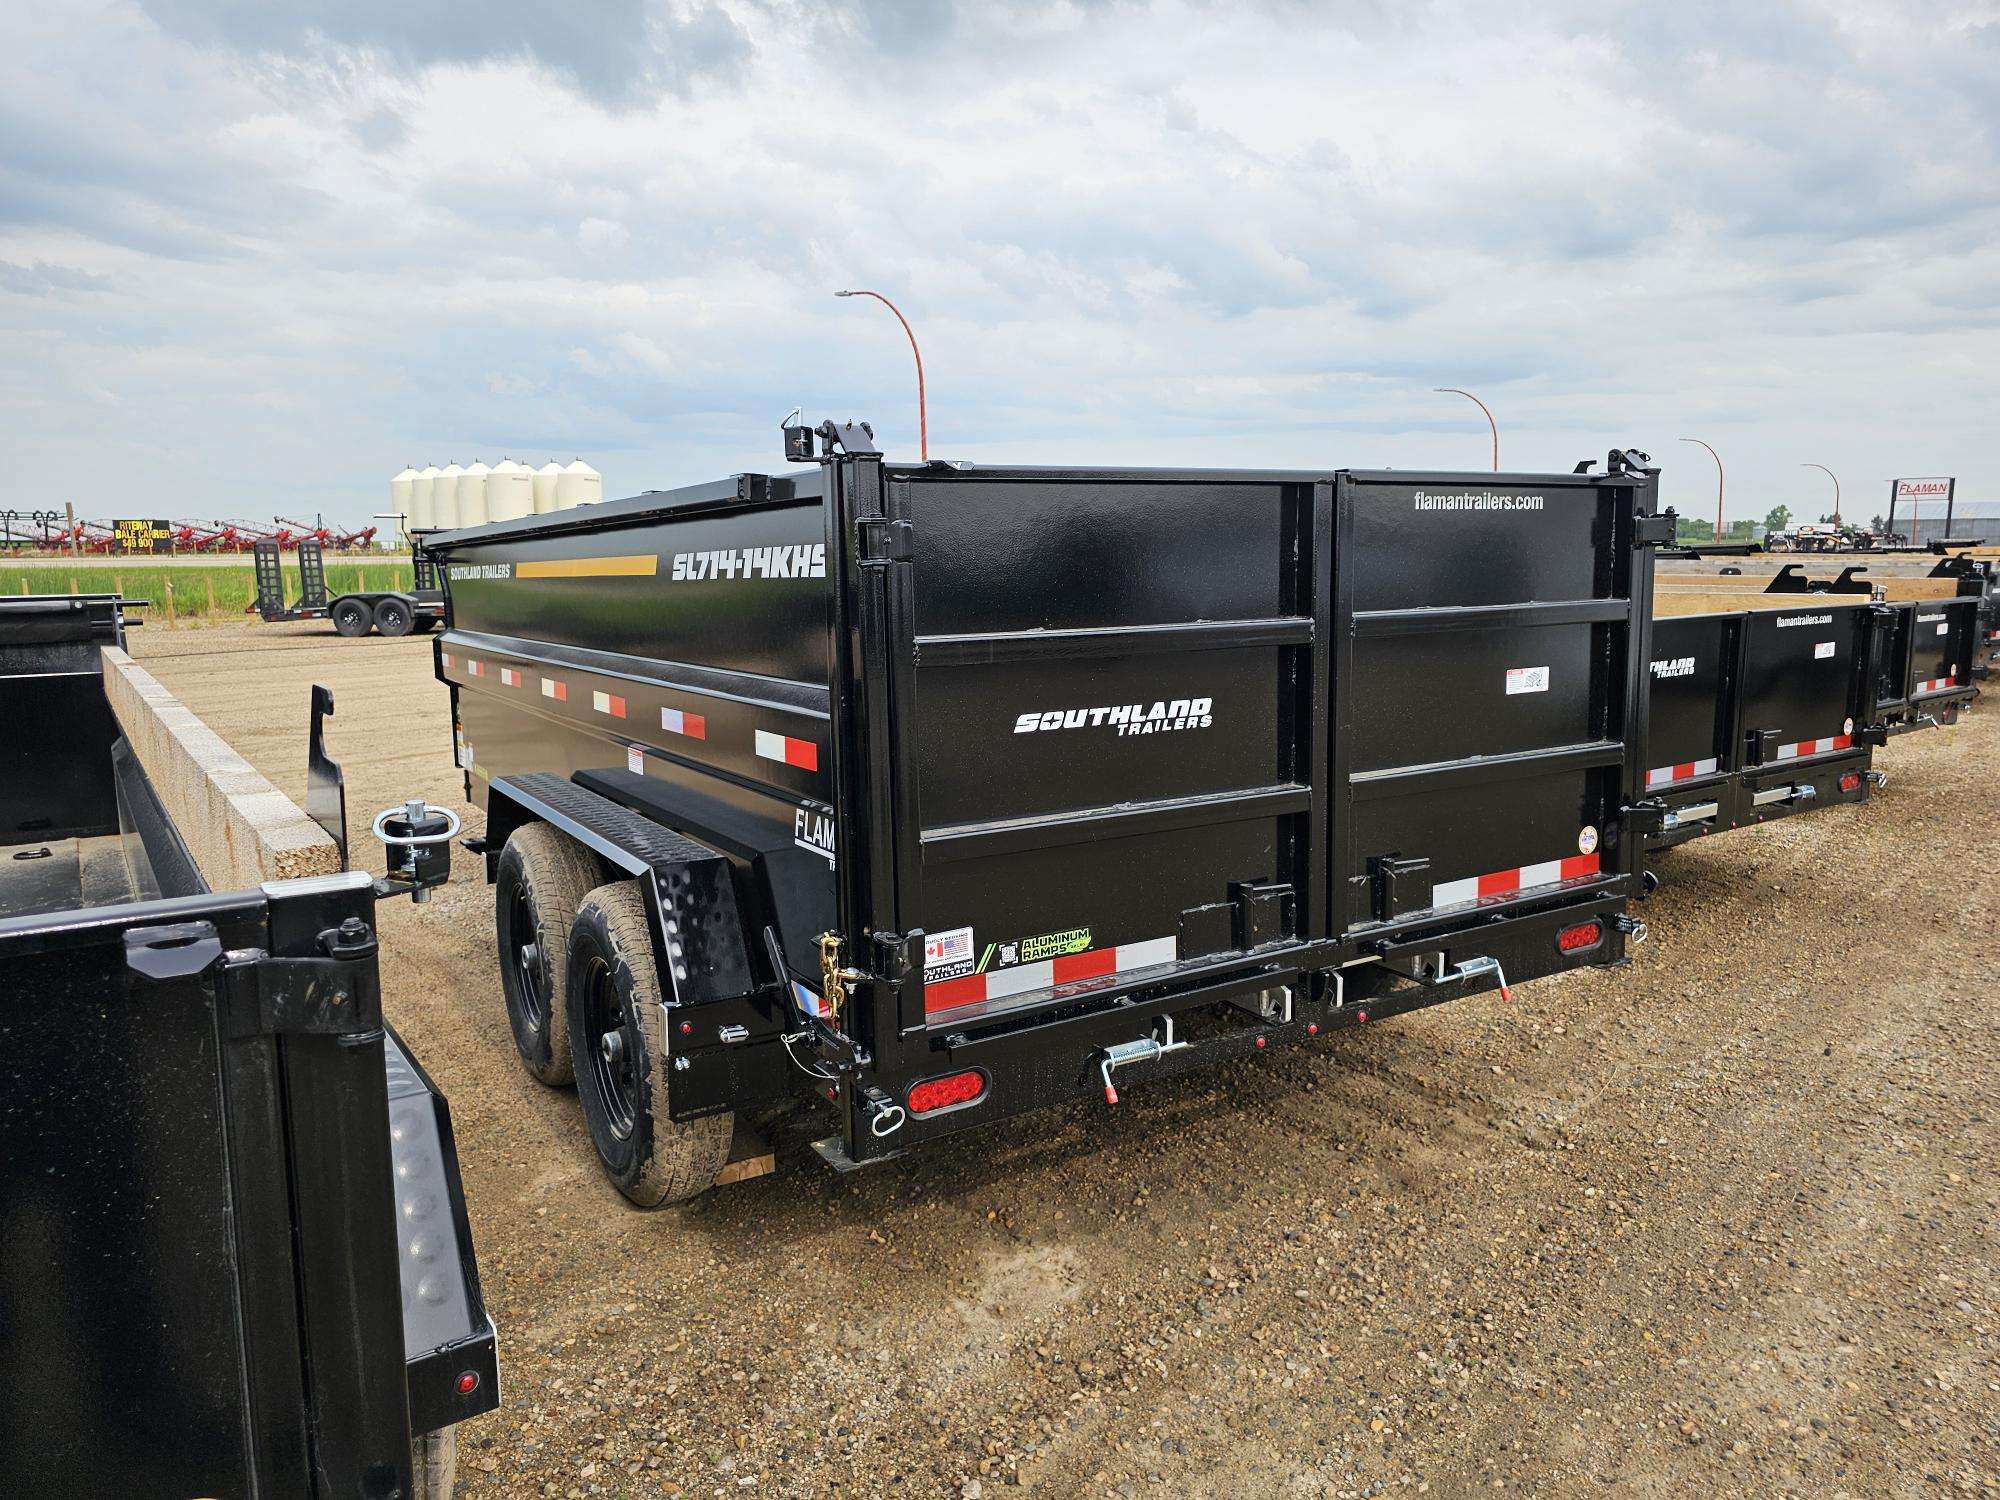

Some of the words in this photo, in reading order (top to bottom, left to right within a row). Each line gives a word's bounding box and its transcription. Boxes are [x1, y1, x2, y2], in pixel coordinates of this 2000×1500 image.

[1899, 483, 1948, 493] FLAMAN
[1414, 491, 1544, 510] flamantrailers.com
[115, 529, 137, 539] BALE
[138, 529, 171, 539] CARRIER
[672, 543, 827, 581] SL714-14KHS
[450, 565, 481, 580] SOUTHLAND
[482, 563, 510, 578] TRAILERS
[1776, 614, 1832, 628] flamantrailers.com
[1013, 697, 1213, 734] SOUTHLAND
[1117, 714, 1213, 737] TRAILERS
[1022, 928, 1090, 951] ALUMINUM
[1022, 943, 1068, 961] RAMPS
